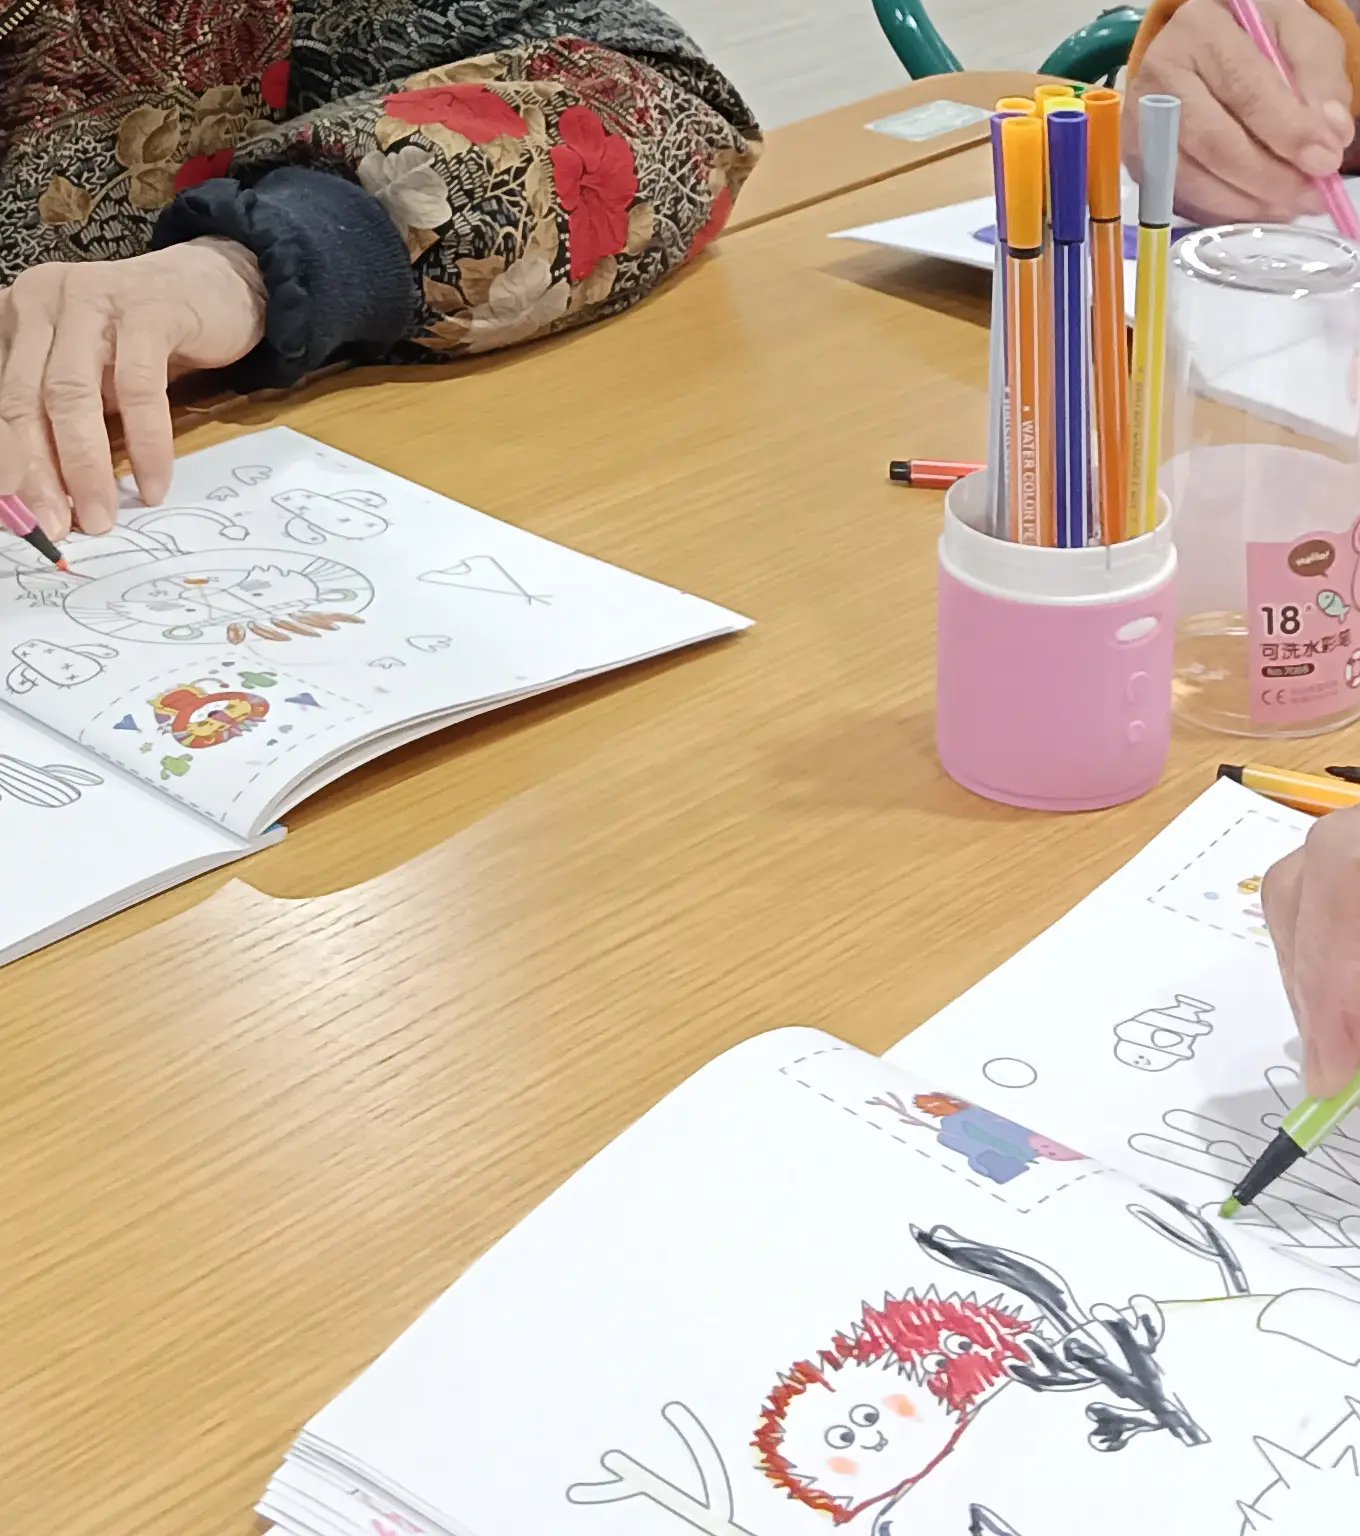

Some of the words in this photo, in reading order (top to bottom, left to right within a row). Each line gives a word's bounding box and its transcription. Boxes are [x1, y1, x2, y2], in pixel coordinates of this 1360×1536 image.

[1022, 419, 1036, 469] WATER
[1261, 605, 1301, 635] 18
[1260, 629, 1351, 661] 可洗水彩笔
